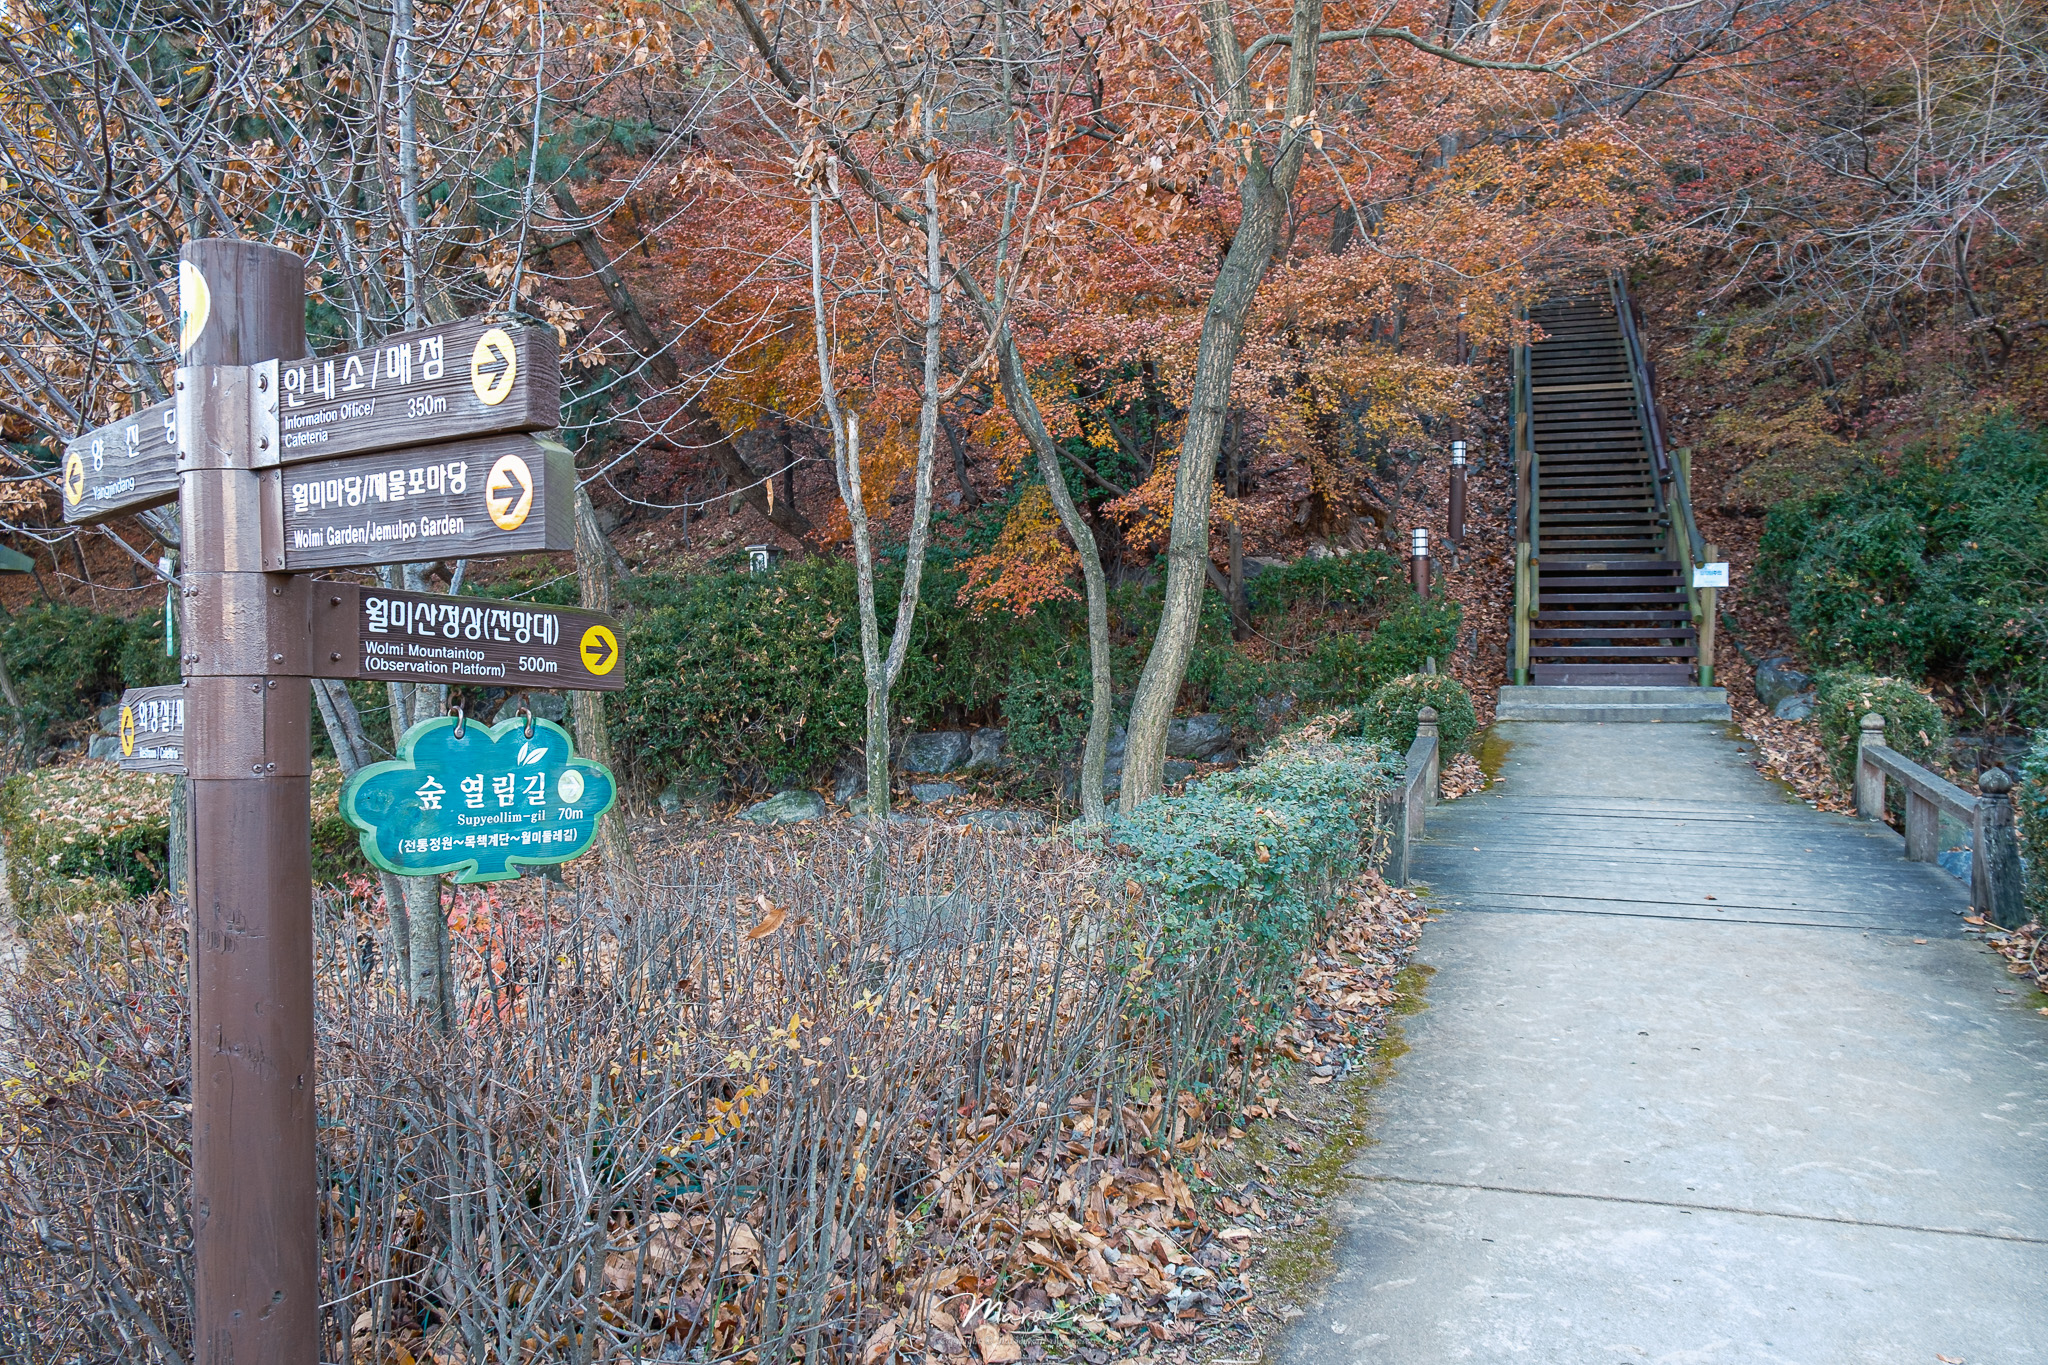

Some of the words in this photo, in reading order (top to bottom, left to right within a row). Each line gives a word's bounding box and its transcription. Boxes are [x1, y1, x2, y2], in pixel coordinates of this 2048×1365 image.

[284, 335, 444, 408] 안내소/매점
[285, 407, 338, 430] Information
[340, 397, 376, 420] Office/
[407, 394, 447, 419] 350m
[285, 429, 329, 448] Cafeteria
[292, 461, 468, 513] 월미마당/제물포마당
[294, 527, 324, 549] Wolmi
[326, 518, 417, 545] Garden/Jemulpo
[420, 514, 464, 538] Garden
[365, 596, 560, 646] 월미산정상(전망대)
[365, 641, 404, 656] Wolmi
[408, 643, 485, 662] Mountaintop
[365, 655, 448, 675] (Observation
[452, 661, 506, 678] Platform)
[518, 656, 558, 673] 500m
[457, 810, 546, 827] Supyeollim-gil
[558, 807, 584, 821] 70m
